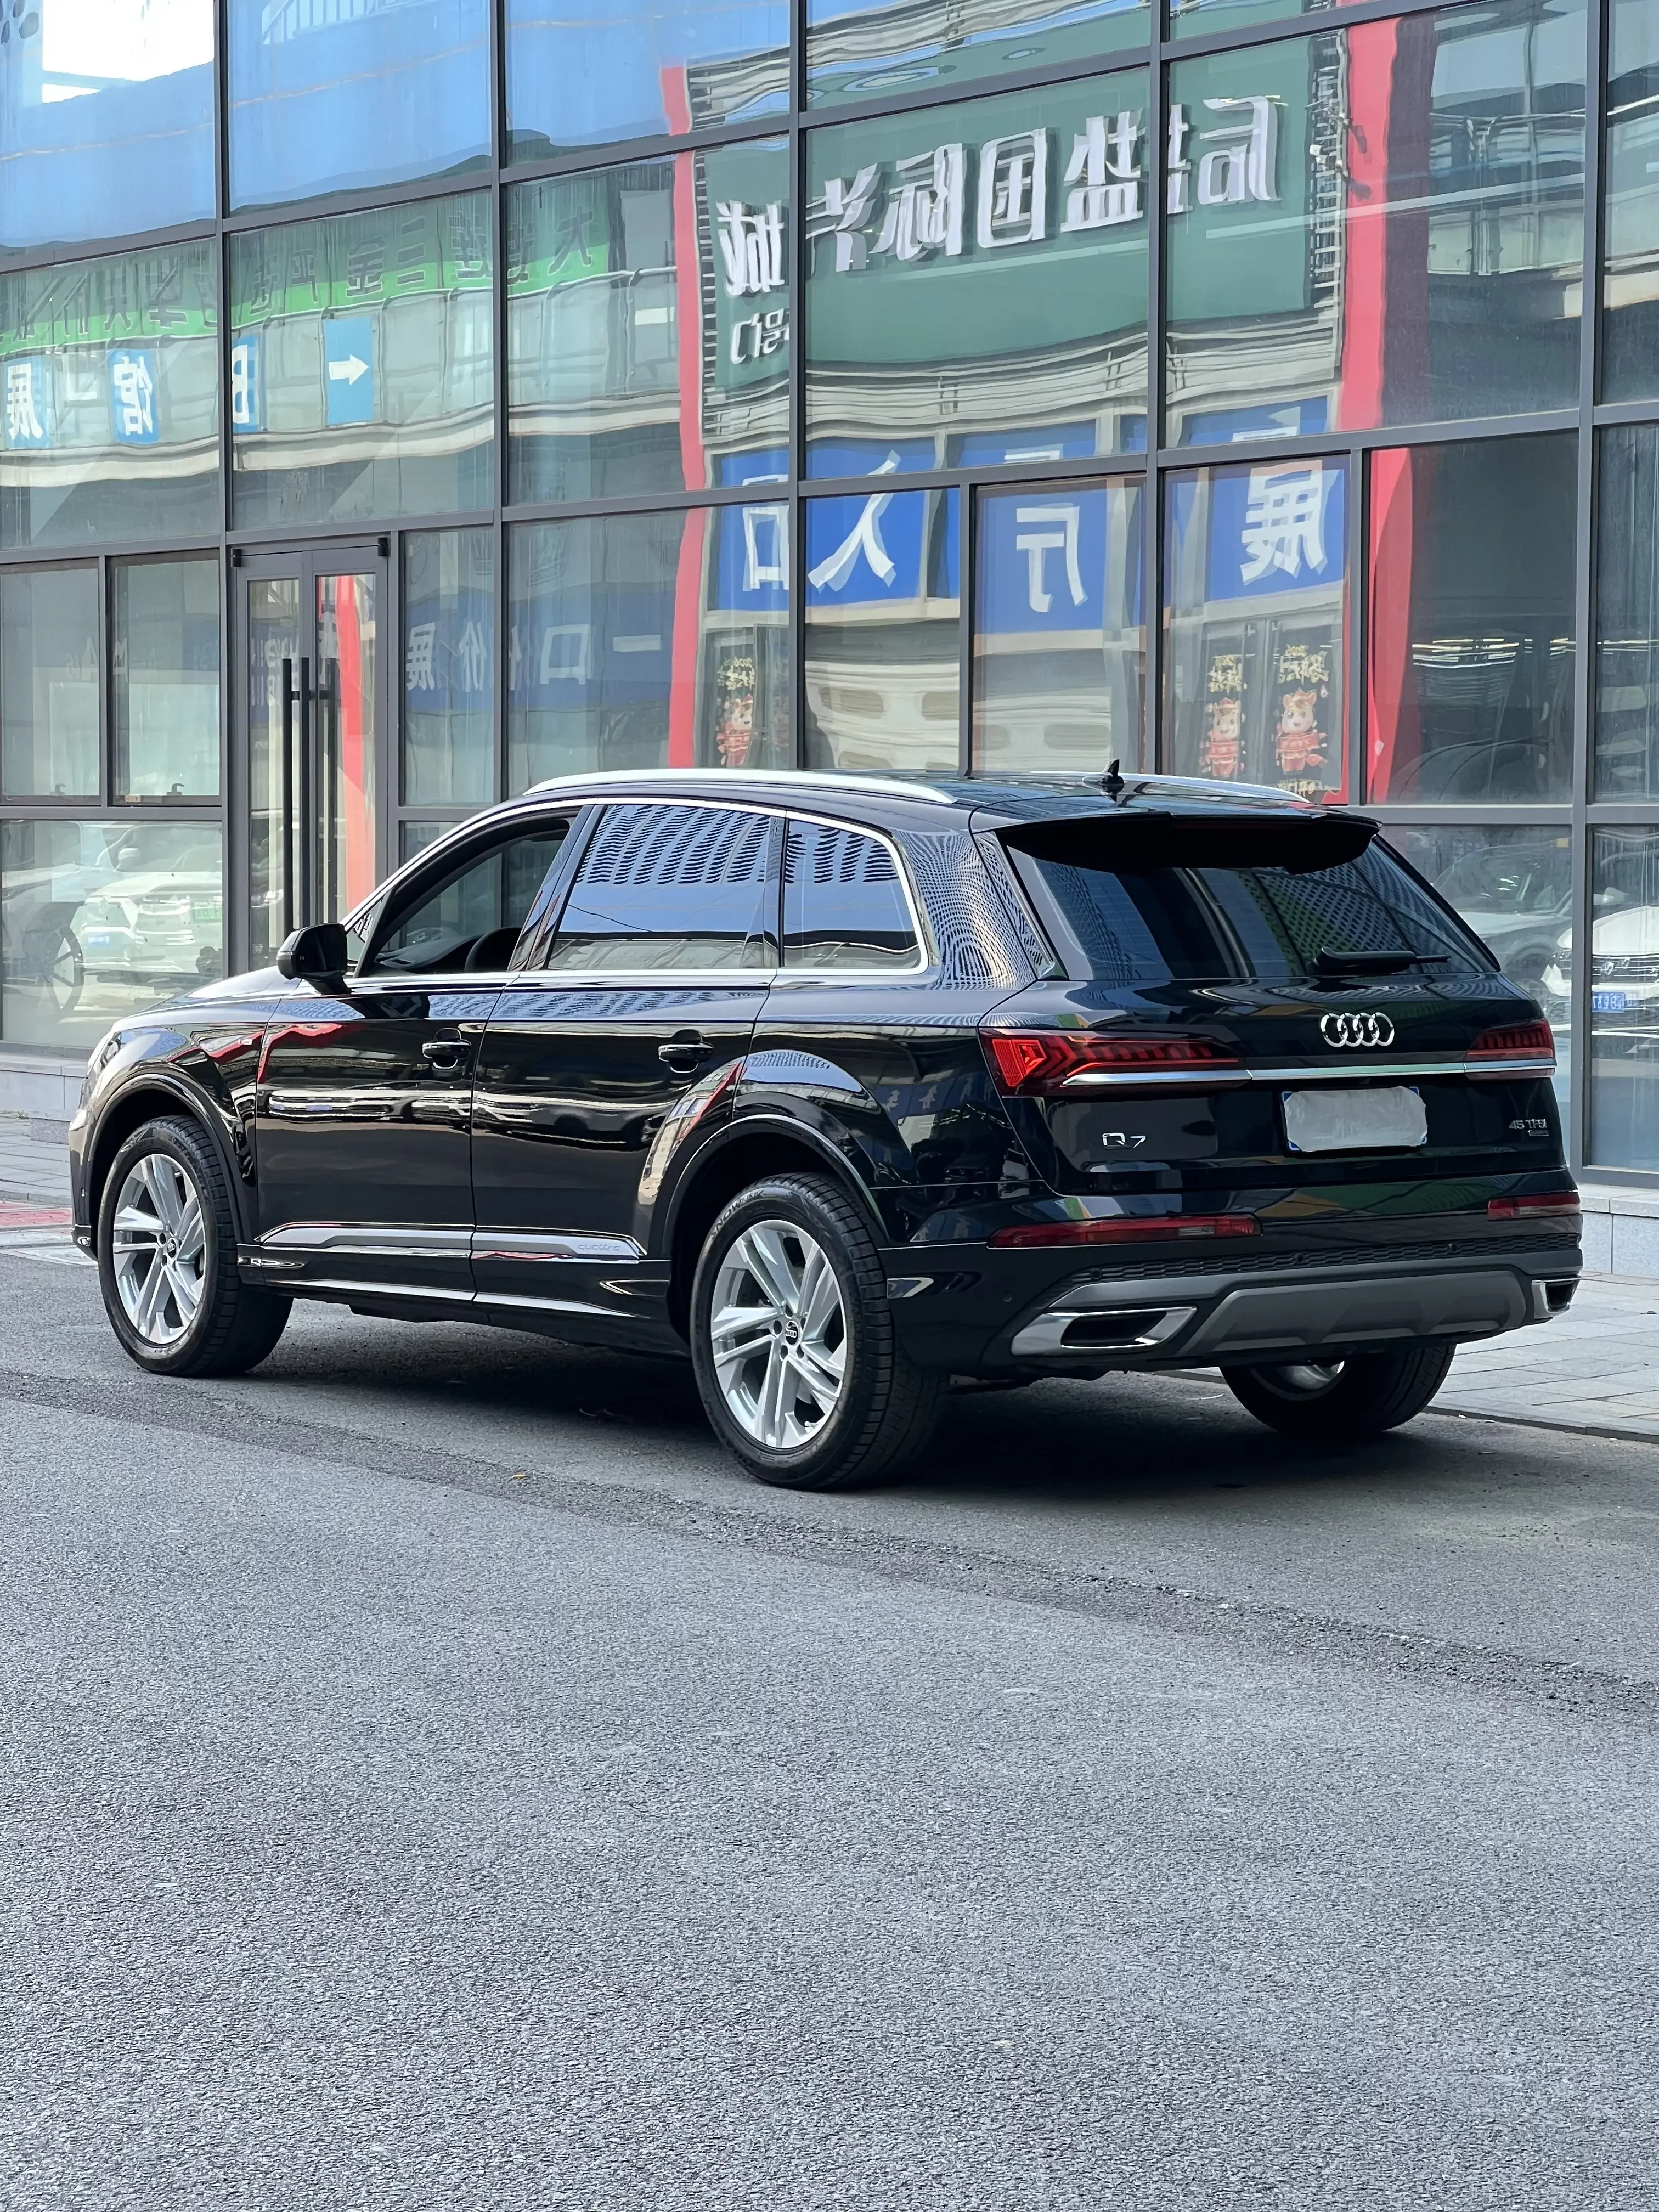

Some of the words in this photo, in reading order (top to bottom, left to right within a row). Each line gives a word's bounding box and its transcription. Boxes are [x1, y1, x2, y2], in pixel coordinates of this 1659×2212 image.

[1509, 1120, 1525, 1129] 45
[1525, 1119, 1548, 1128] TFSI
[1102, 1132, 1147, 1149] Q7
